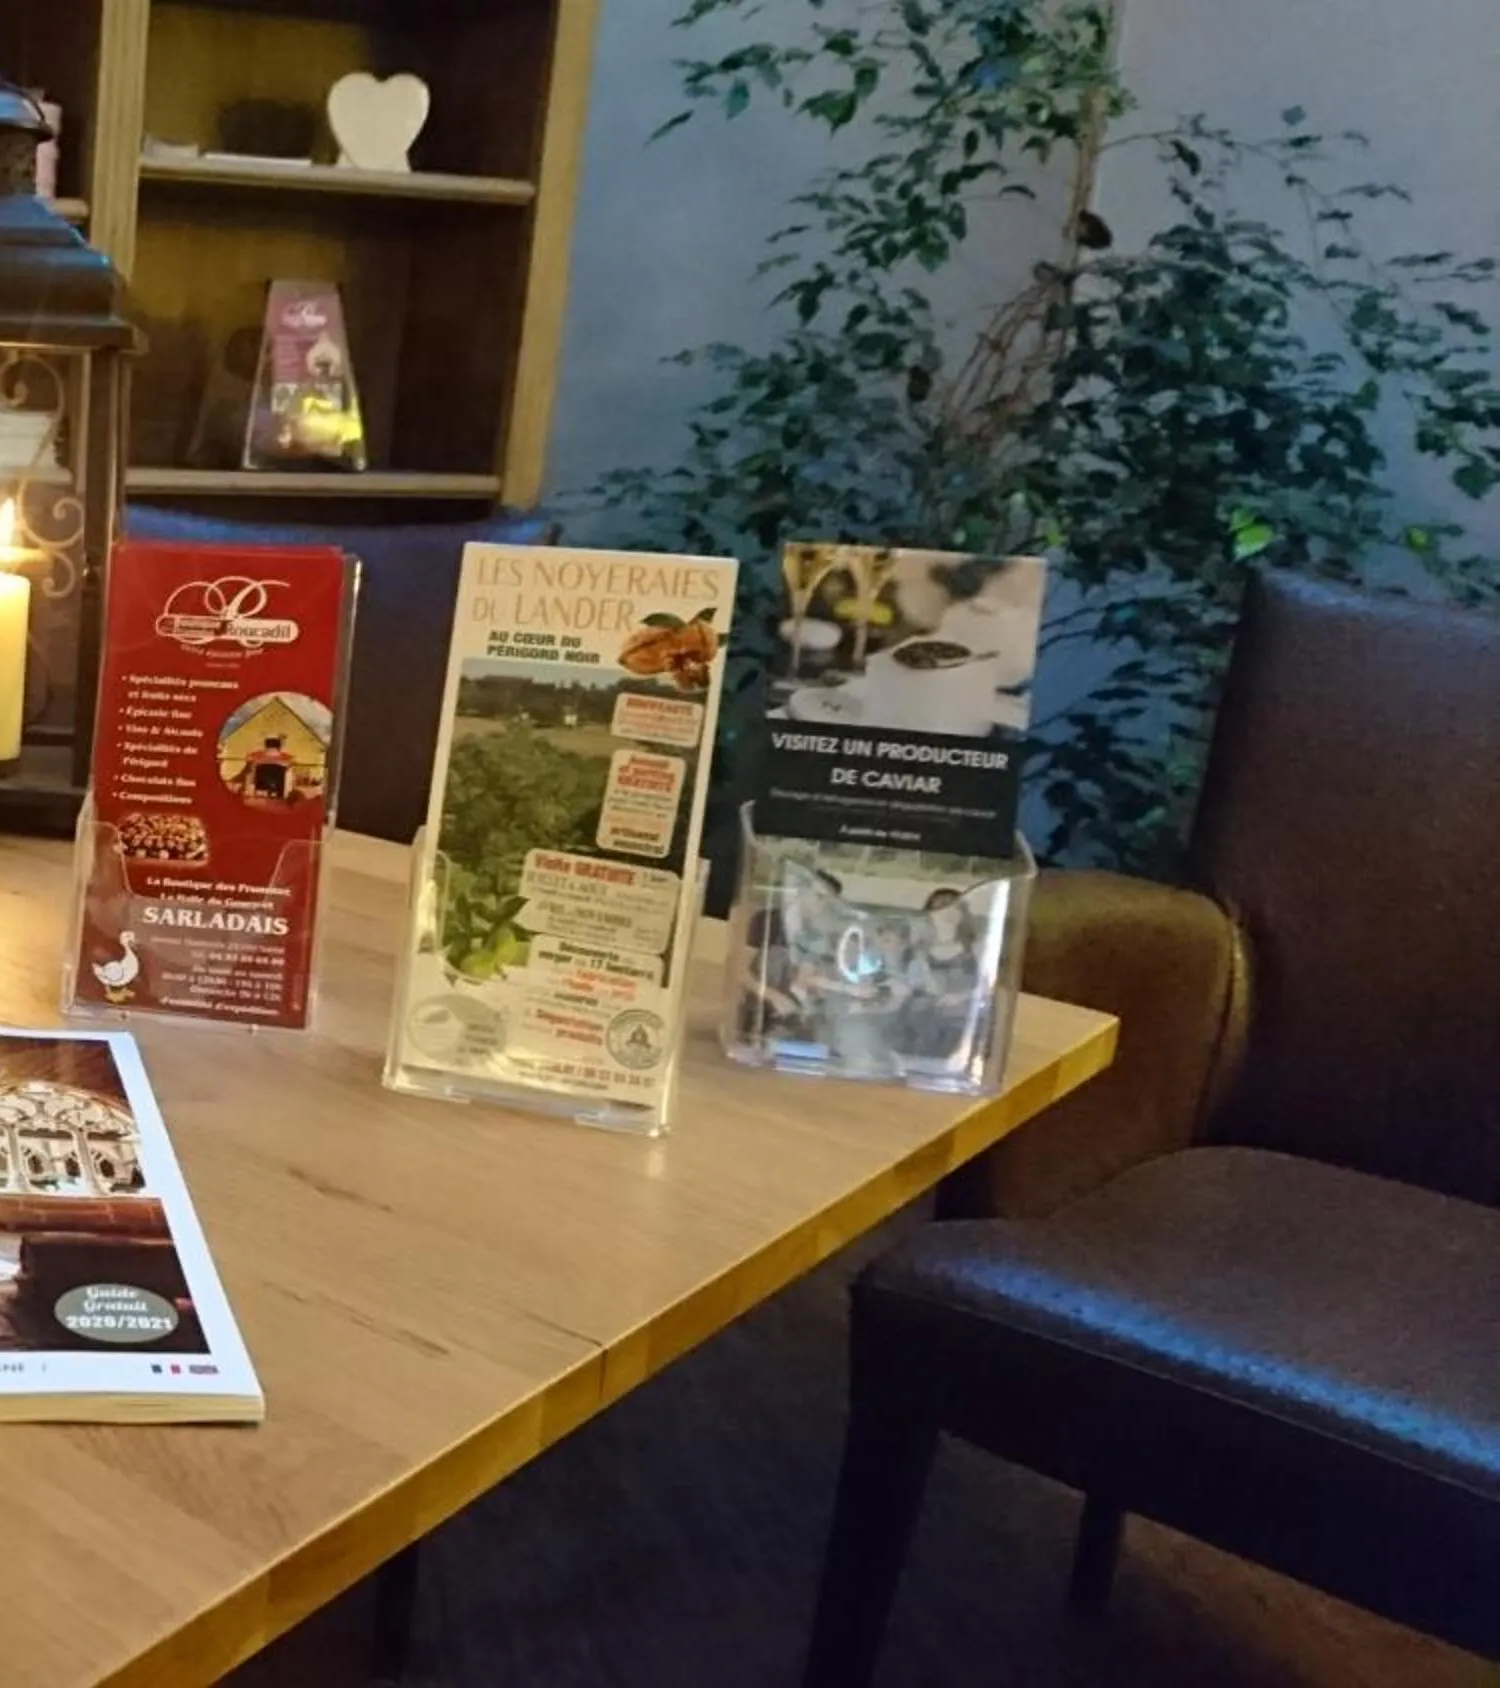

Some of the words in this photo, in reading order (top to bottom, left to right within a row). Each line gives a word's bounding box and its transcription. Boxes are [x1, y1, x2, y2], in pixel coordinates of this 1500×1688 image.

[475, 556, 523, 588] LES
[531, 557, 721, 602] NOYERAIES
[514, 594, 637, 632] LANDER
[488, 630, 509, 643] AU
[560, 636, 582, 649] DU
[565, 650, 600, 665] NOIR
[771, 731, 838, 753] VISITEZ
[842, 740, 872, 757] UN
[876, 742, 1010, 771] PRODUCTEUR
[829, 767, 857, 786] DE
[861, 769, 943, 794] CAVIAR
[147, 876, 160, 886] La
[163, 877, 213, 890] Boutique
[141, 905, 290, 936] SARLADAIS
[85, 1286, 138, 1299] Guide
[83, 1300, 148, 1313] Gratuit
[65, 1315, 174, 1331] 2020/2021
